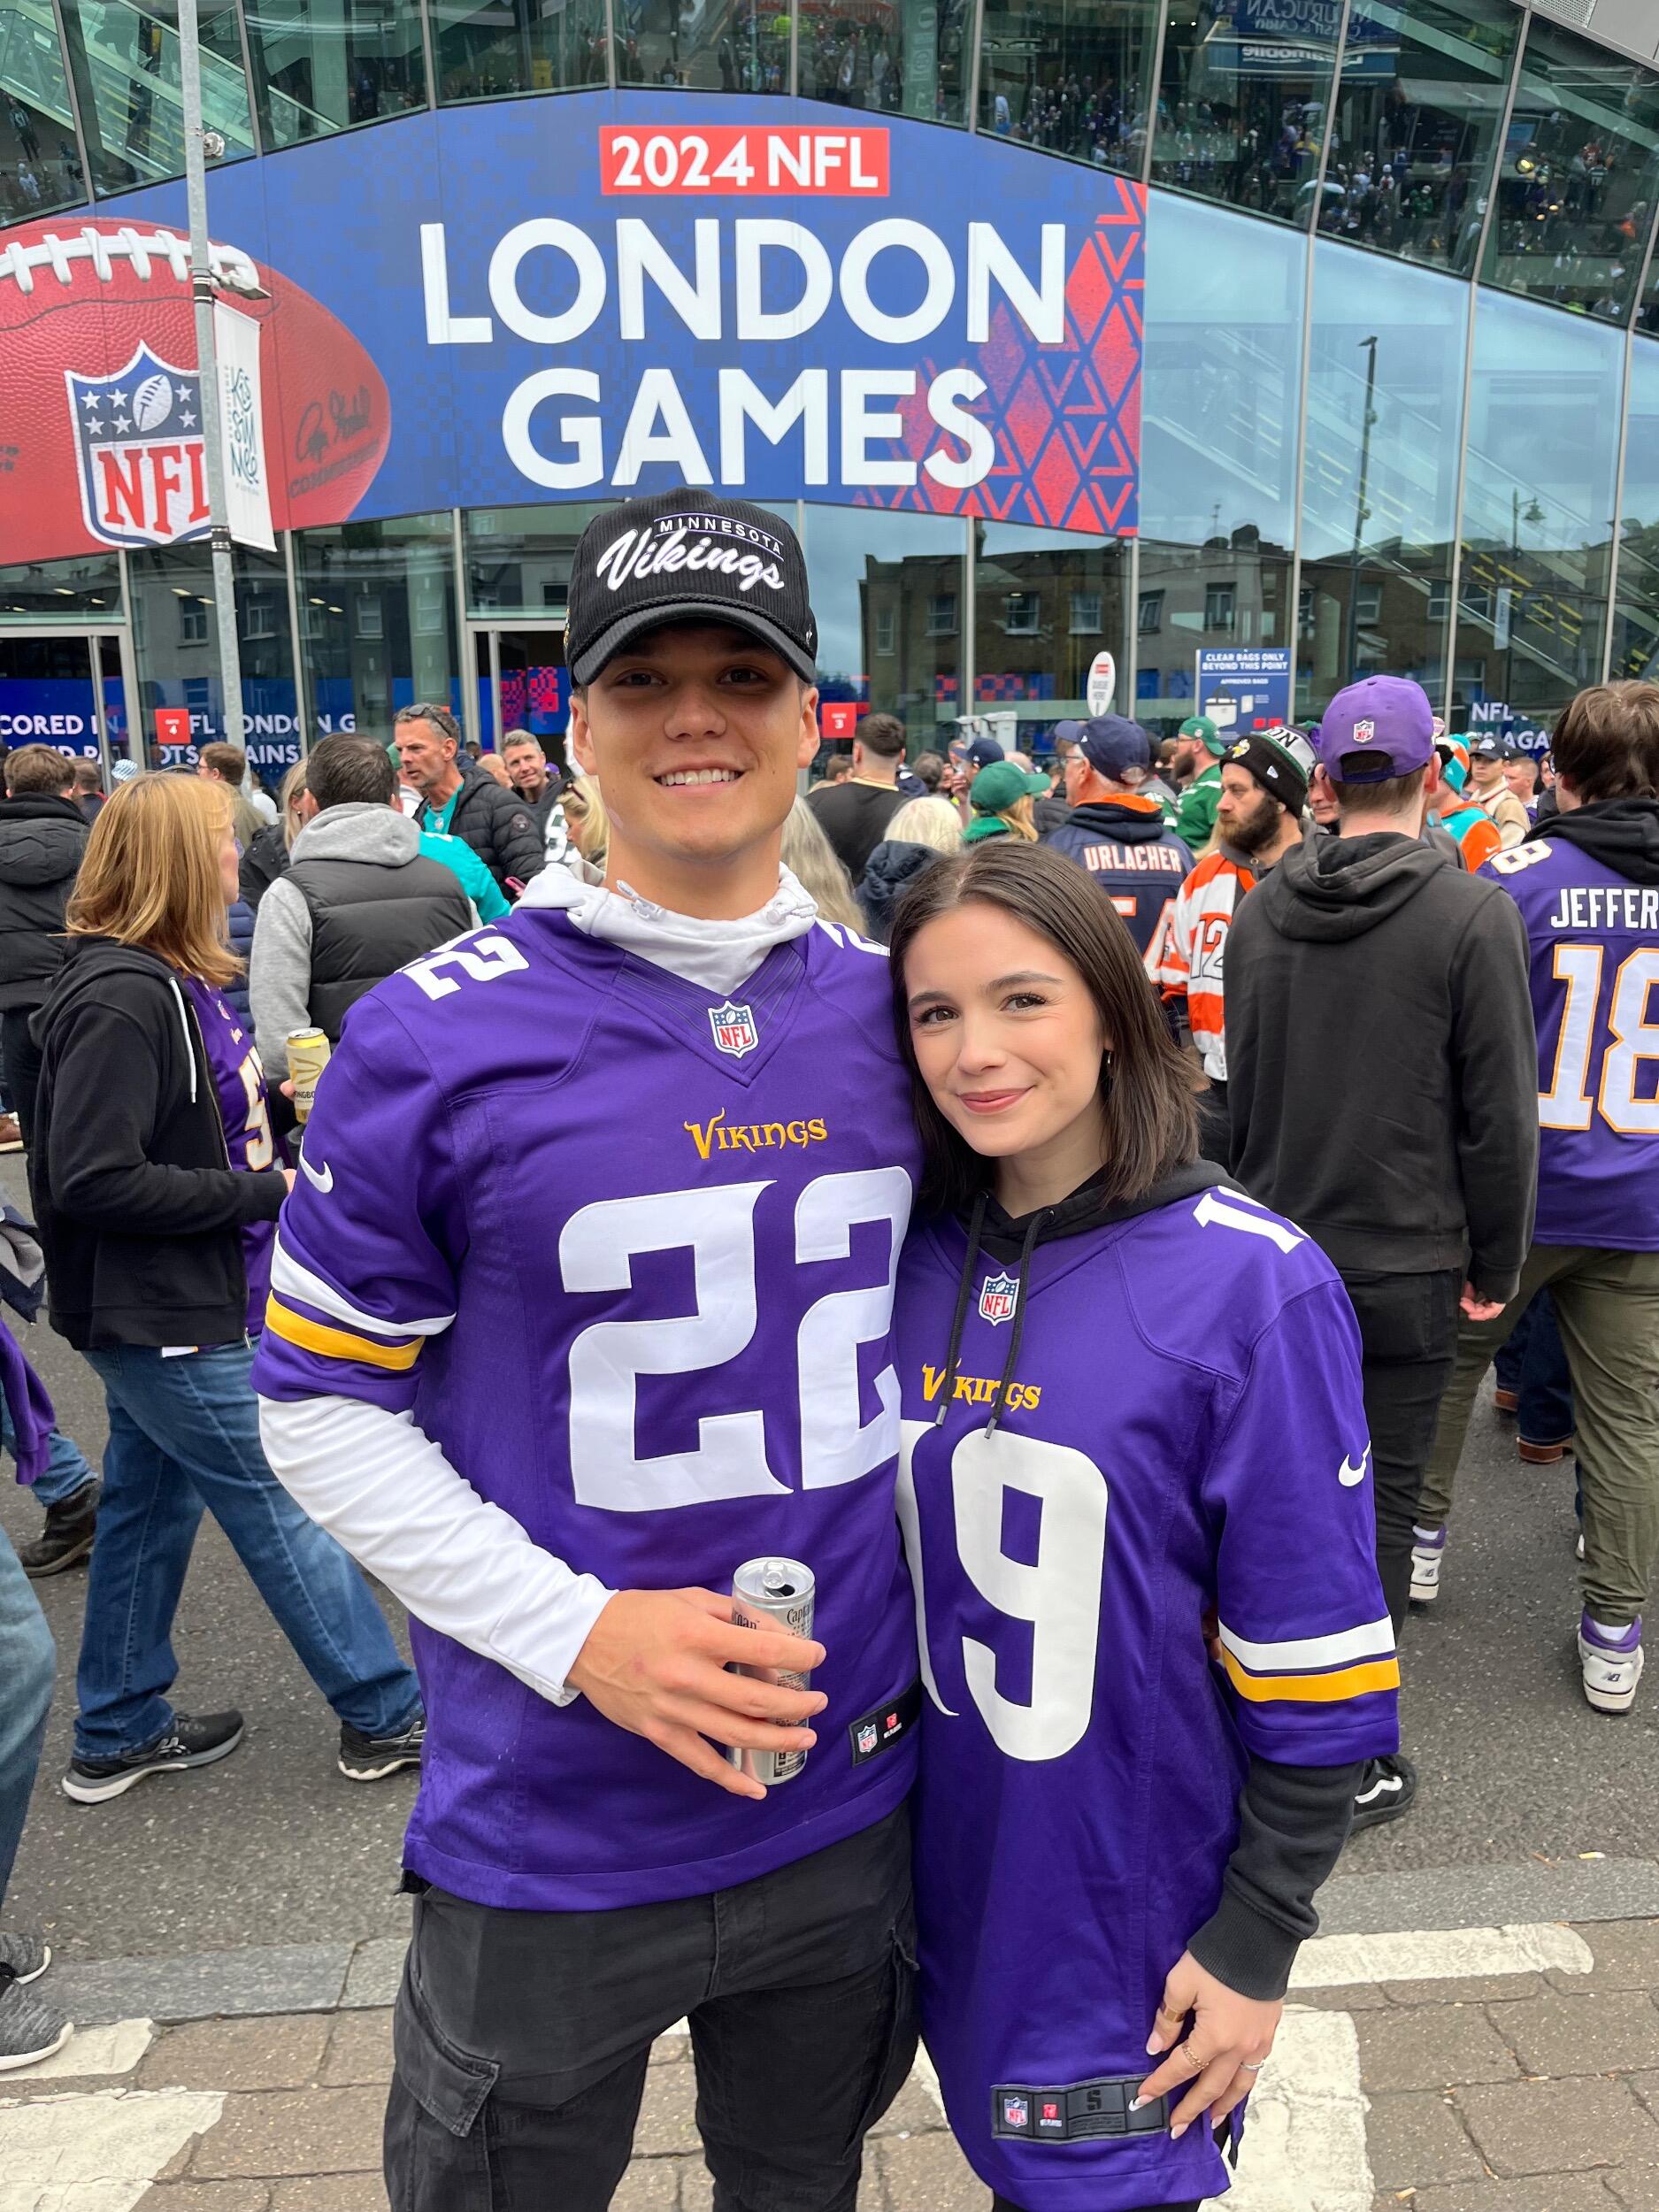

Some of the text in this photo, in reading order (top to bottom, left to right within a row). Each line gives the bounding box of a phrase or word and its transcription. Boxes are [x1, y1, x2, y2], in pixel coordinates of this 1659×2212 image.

[611, 135, 879, 188] 2024 NFL
[419, 218, 1065, 344] LONDON
[502, 367, 995, 489] GAMES
[660, 517, 781, 556] MINNESOTA
[596, 527, 785, 591] Vikings
[1261, 661, 1288, 670] POINT
[0, 715, 84, 735] CORED
[189, 715, 216, 734] FL
[834, 718, 843, 729] 3
[1471, 702, 1514, 721] NFL
[169, 725, 177, 735] 4
[1084, 845, 1182, 873] URLACHER
[1550, 887, 1659, 930] JEFFER
[718, 1025, 752, 1048] NFL
[1538, 944, 1659, 1134] 18
[983, 1294, 1010, 1317] NFL
[558, 1165, 913, 1513] 22
[1087, 2089, 1102, 2111] S
